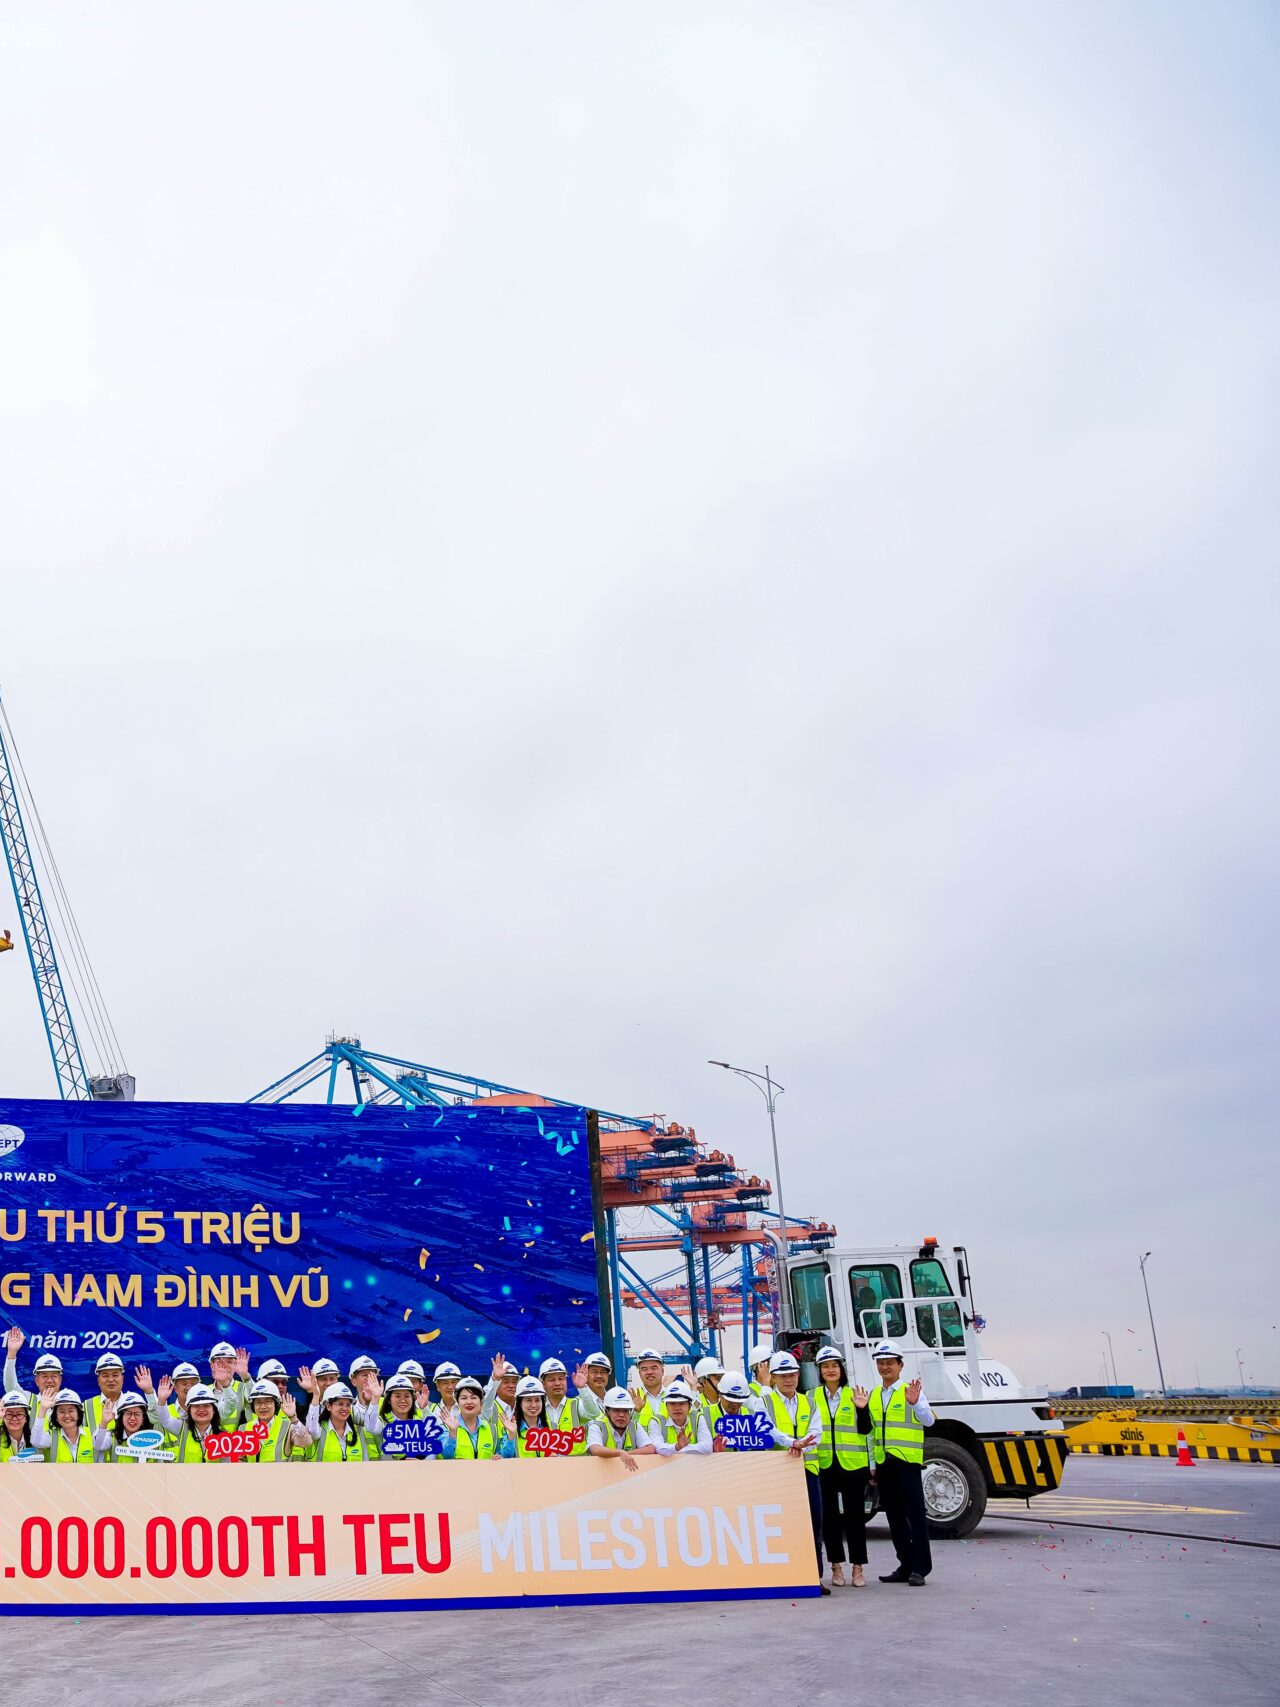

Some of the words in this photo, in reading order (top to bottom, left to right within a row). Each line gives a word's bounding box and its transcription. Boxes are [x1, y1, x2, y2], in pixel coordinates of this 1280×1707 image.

[37, 1202, 128, 1244] THỨ
[136, 1211, 166, 1244] 5
[173, 1203, 301, 1253] TRIỆU
[43, 1273, 143, 1307] NAM
[154, 1265, 260, 1308] ĐÌNH
[269, 1266, 329, 1308] VŨ
[29, 1330, 77, 1349] năm
[82, 1331, 134, 1349] 2025
[958, 1372, 1008, 1388] NV02
[386, 1423, 420, 1440] #5M
[717, 1418, 751, 1433] #5M
[1120, 1428, 1145, 1441] stinis
[208, 1435, 255, 1457] 2025
[404, 1441, 433, 1453] TEUs
[528, 1431, 572, 1452] 2025
[735, 1435, 764, 1447] TEUs
[342, 1512, 452, 1576] TEU
[477, 1503, 790, 1574] MILESTONE
